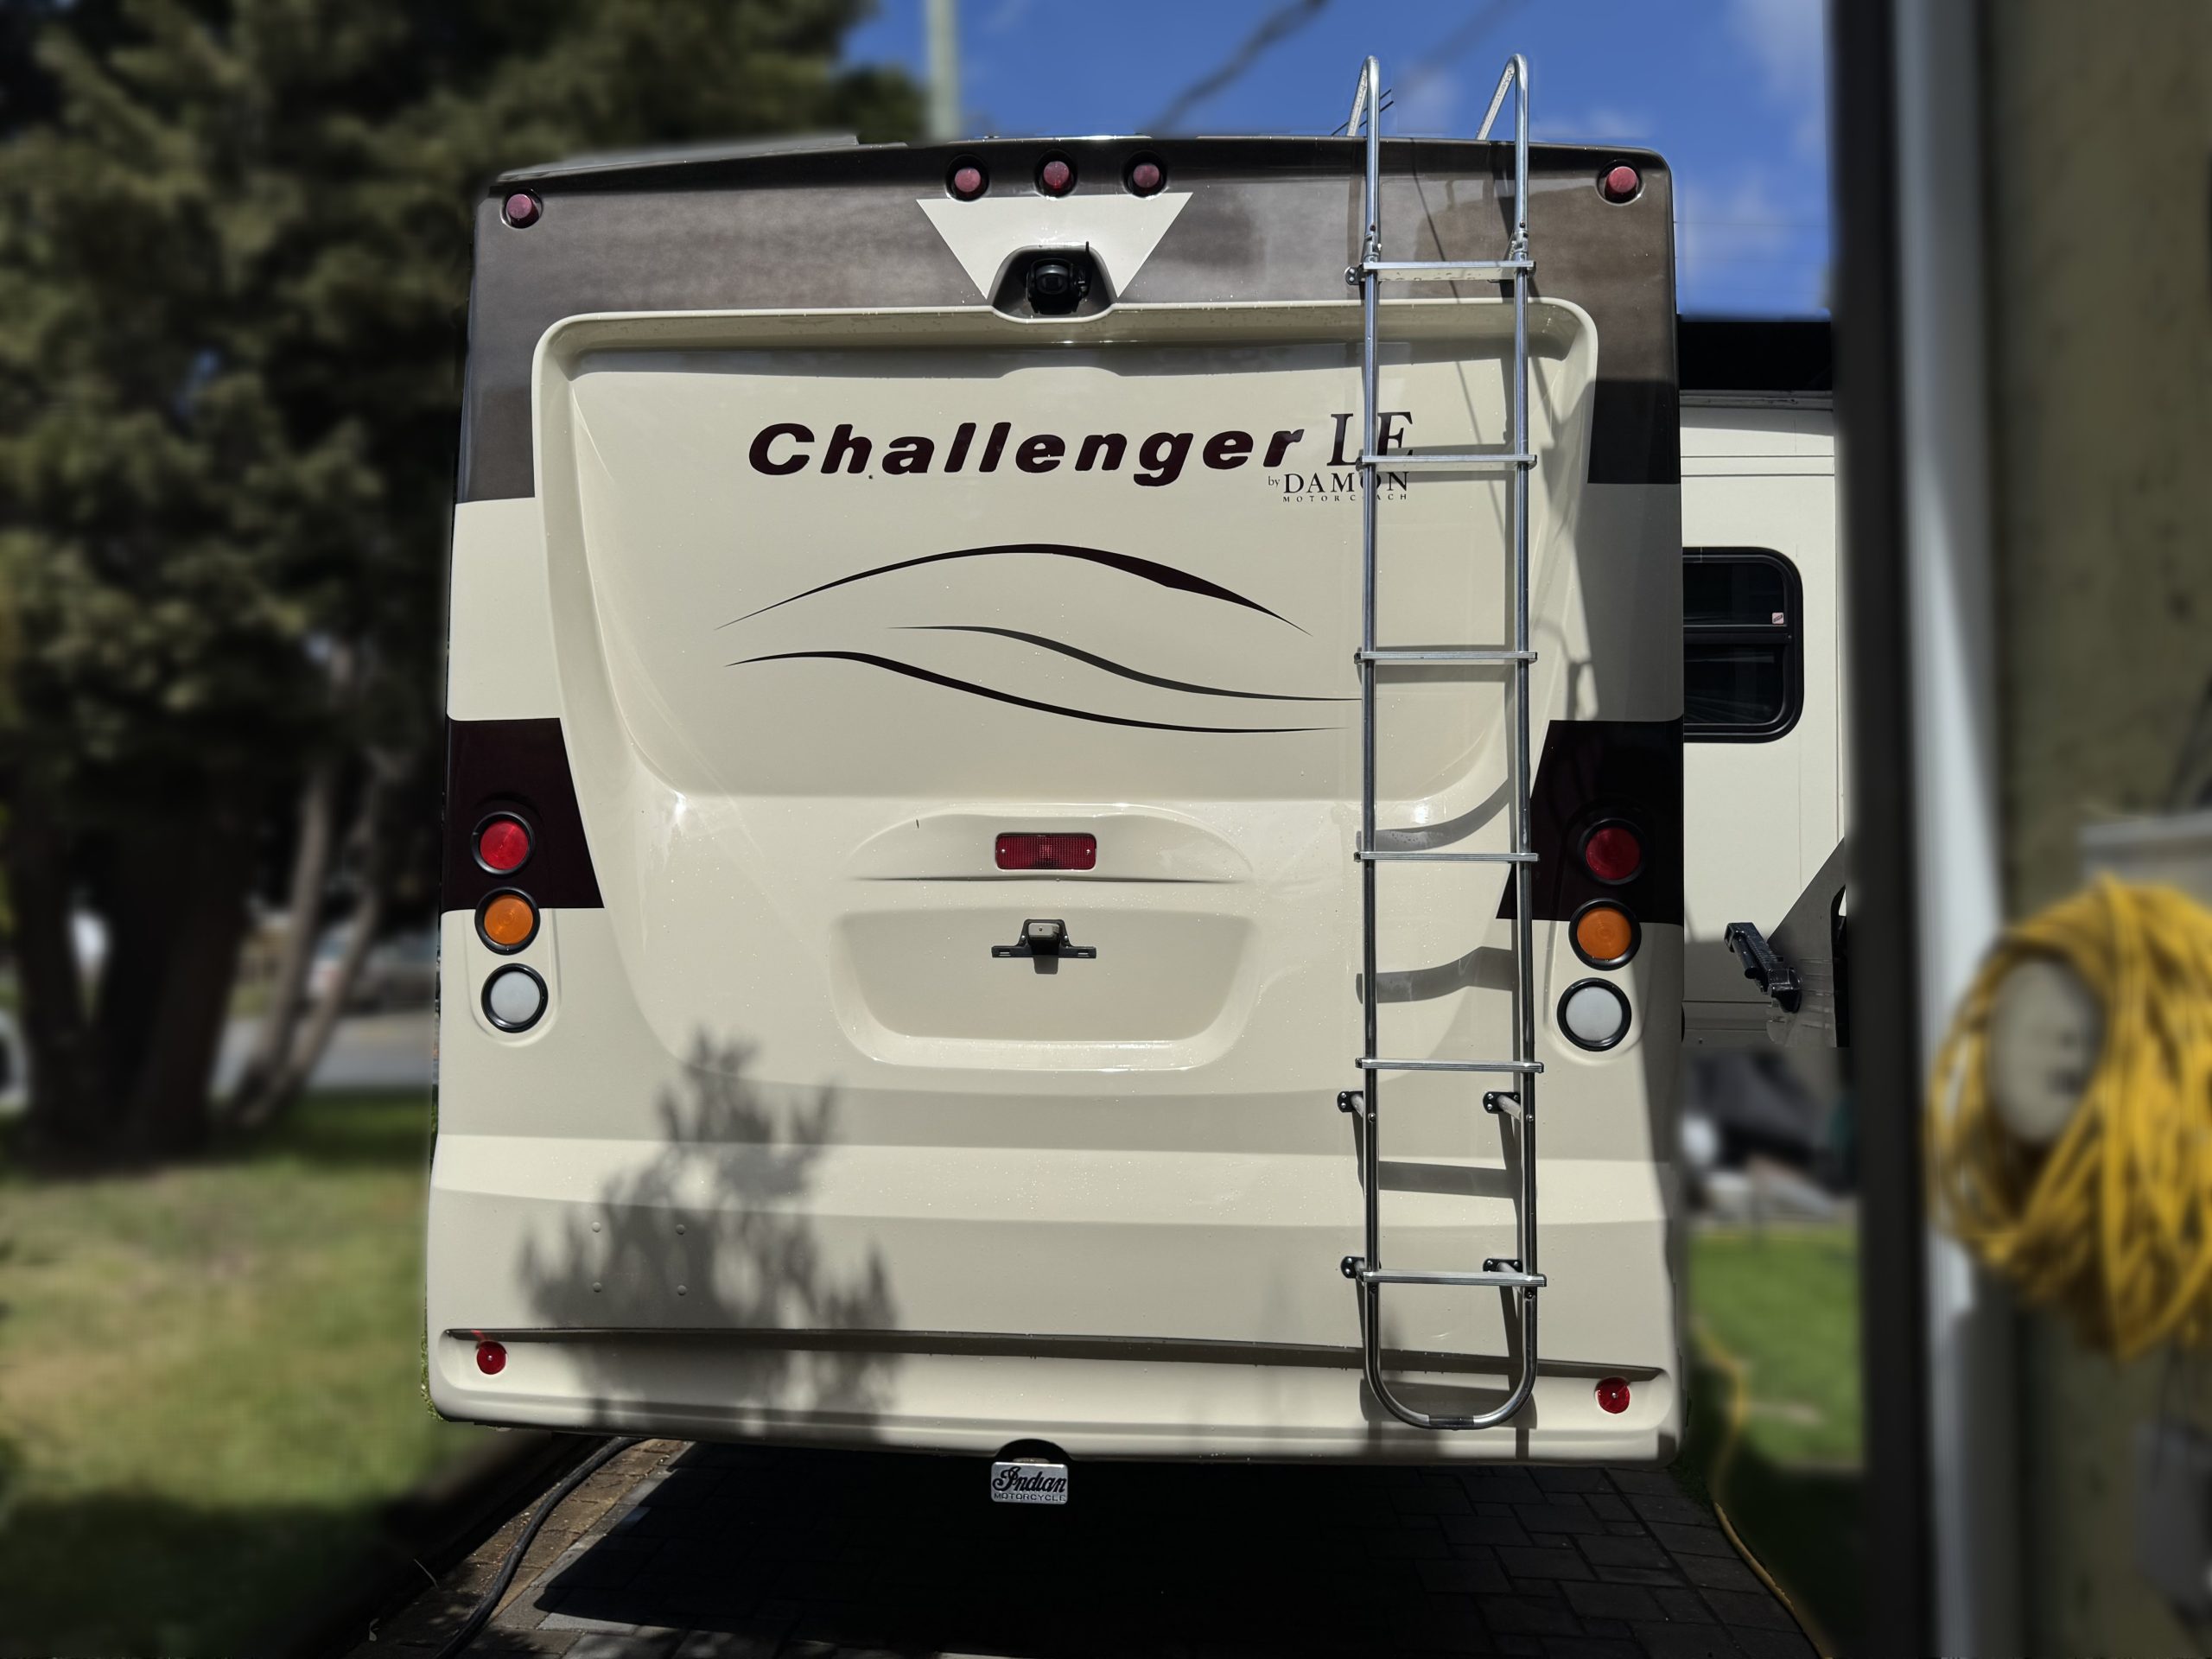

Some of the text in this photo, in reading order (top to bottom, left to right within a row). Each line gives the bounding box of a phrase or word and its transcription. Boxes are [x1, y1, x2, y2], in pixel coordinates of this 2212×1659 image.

[748, 410, 1414, 487] Challenger LE
[1268, 475, 1281, 487] by
[992, 1465, 1067, 1493] Indian
[994, 1492, 1066, 1503] MOTORCYCLE
